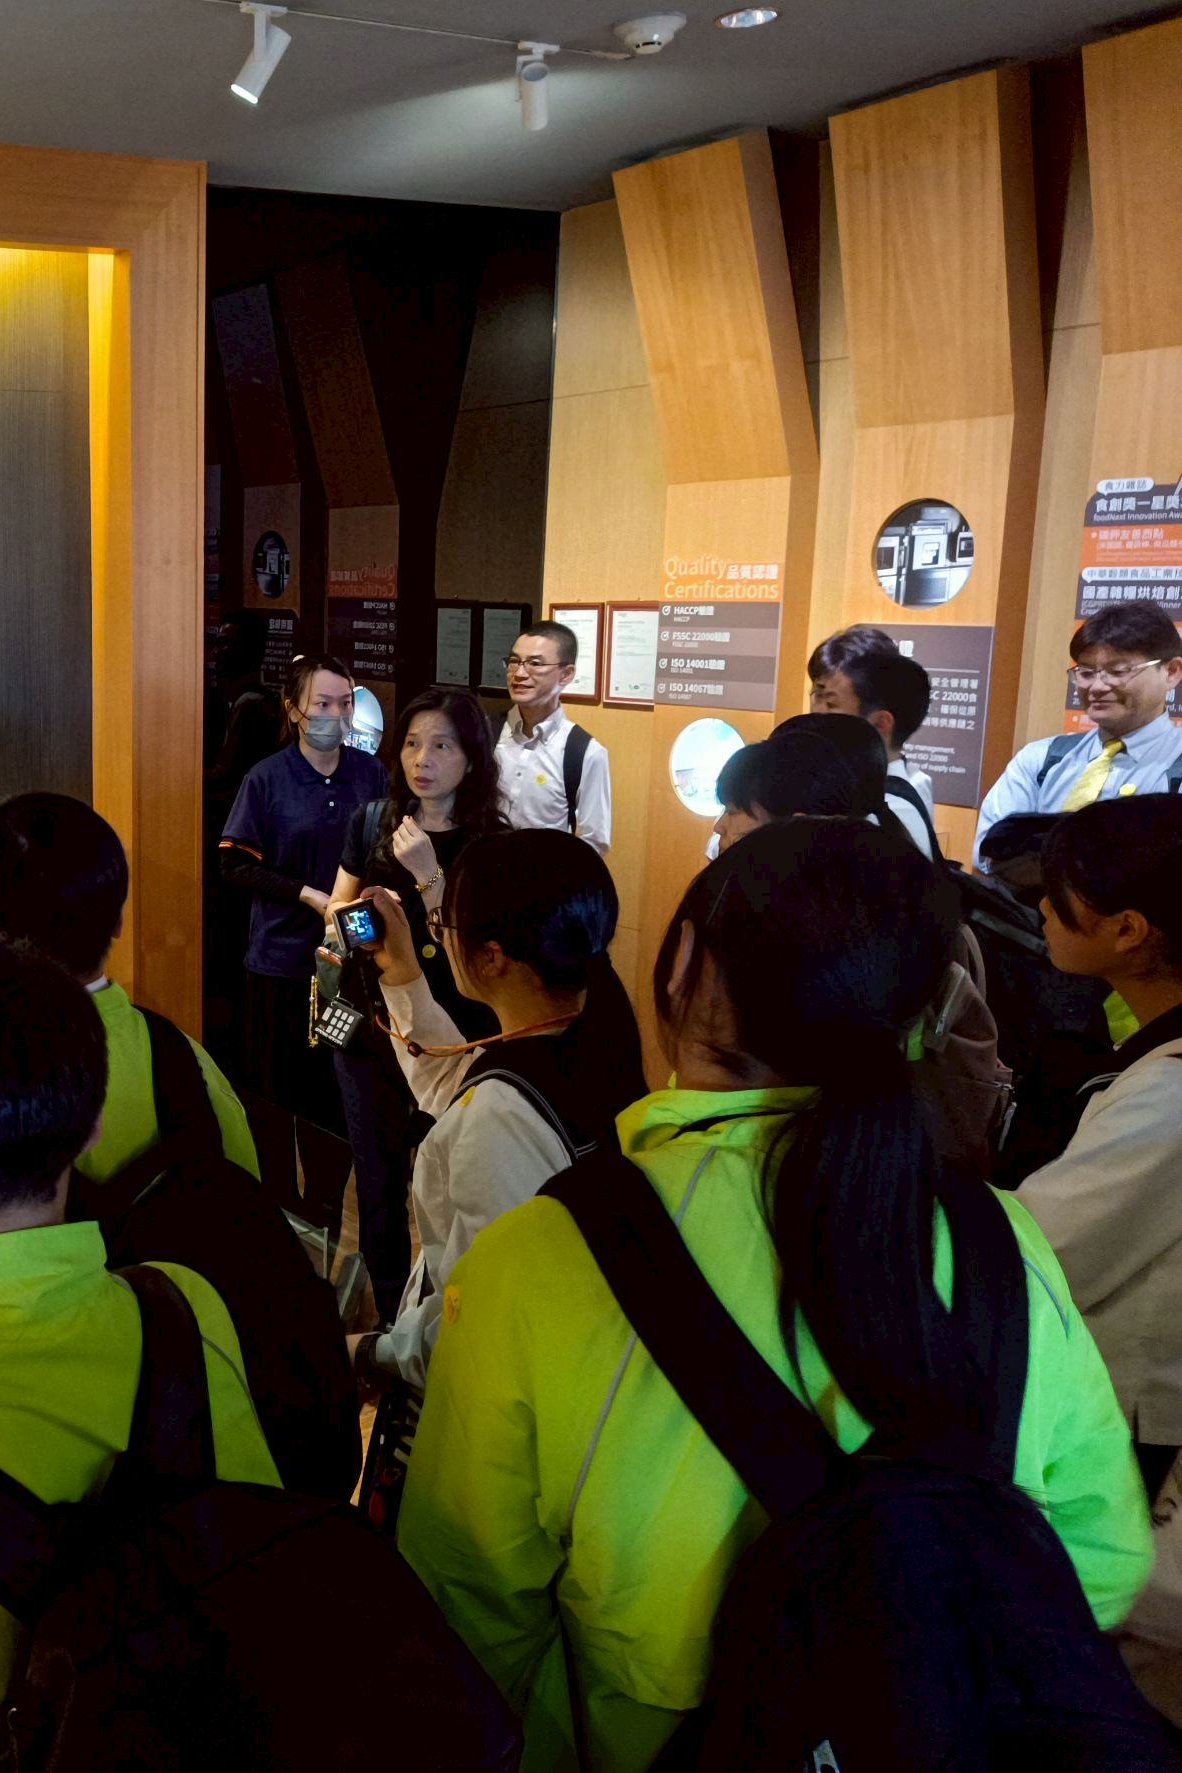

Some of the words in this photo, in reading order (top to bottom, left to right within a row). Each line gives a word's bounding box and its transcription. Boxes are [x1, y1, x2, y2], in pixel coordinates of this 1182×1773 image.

[1127, 511, 1167, 520] Innovation
[665, 554, 727, 580] Quality
[664, 579, 779, 599] Certifications
[671, 658, 685, 667] ISO
[669, 682, 683, 692] ISO
